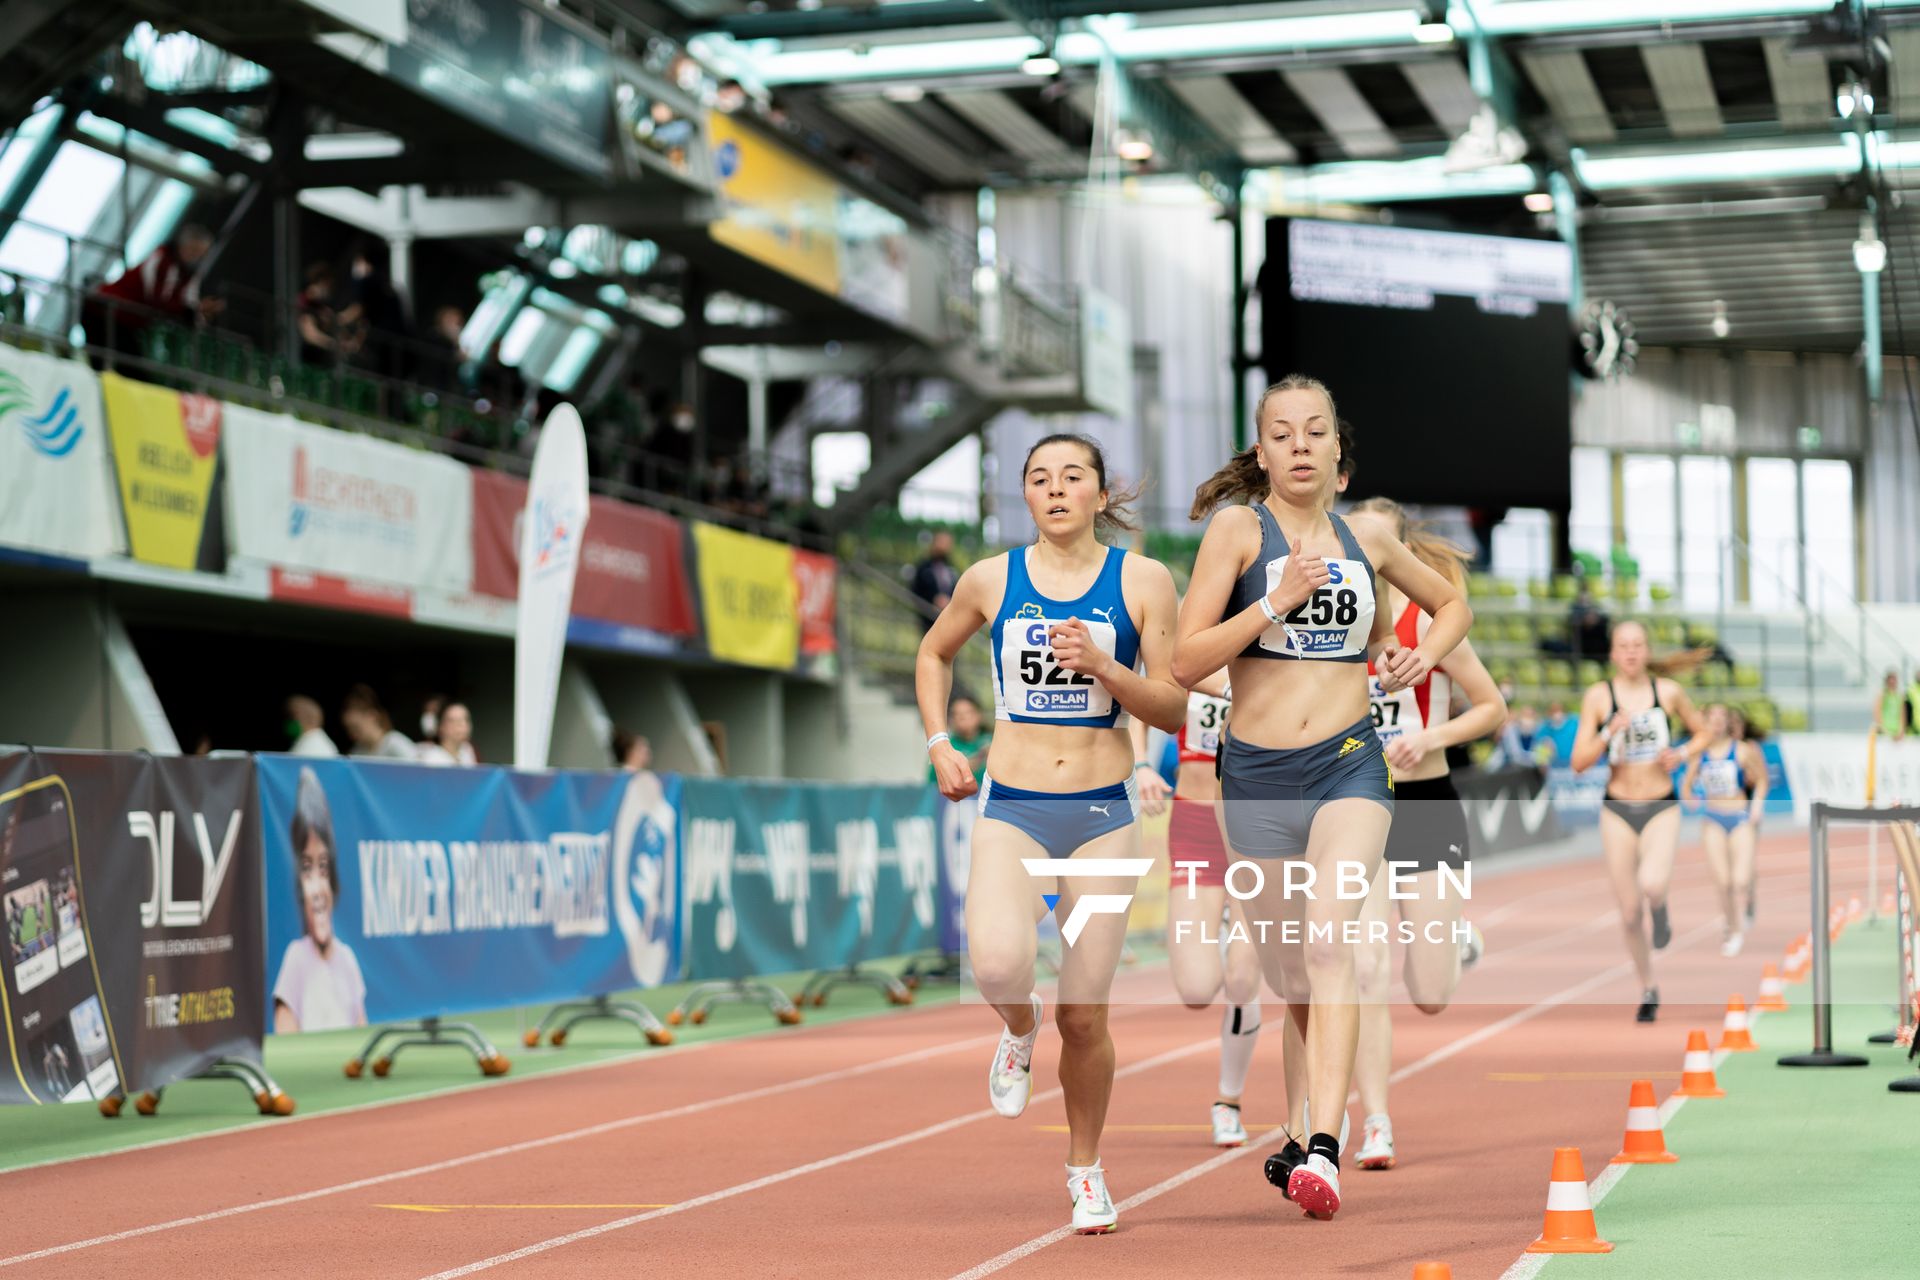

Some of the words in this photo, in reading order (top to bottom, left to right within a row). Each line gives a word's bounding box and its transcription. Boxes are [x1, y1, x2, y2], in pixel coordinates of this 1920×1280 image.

[1285, 588, 1358, 625] 258
[1314, 633, 1345, 644] PLAN
[1051, 693, 1086, 704] PLAN
[358, 839, 452, 938] KINDER
